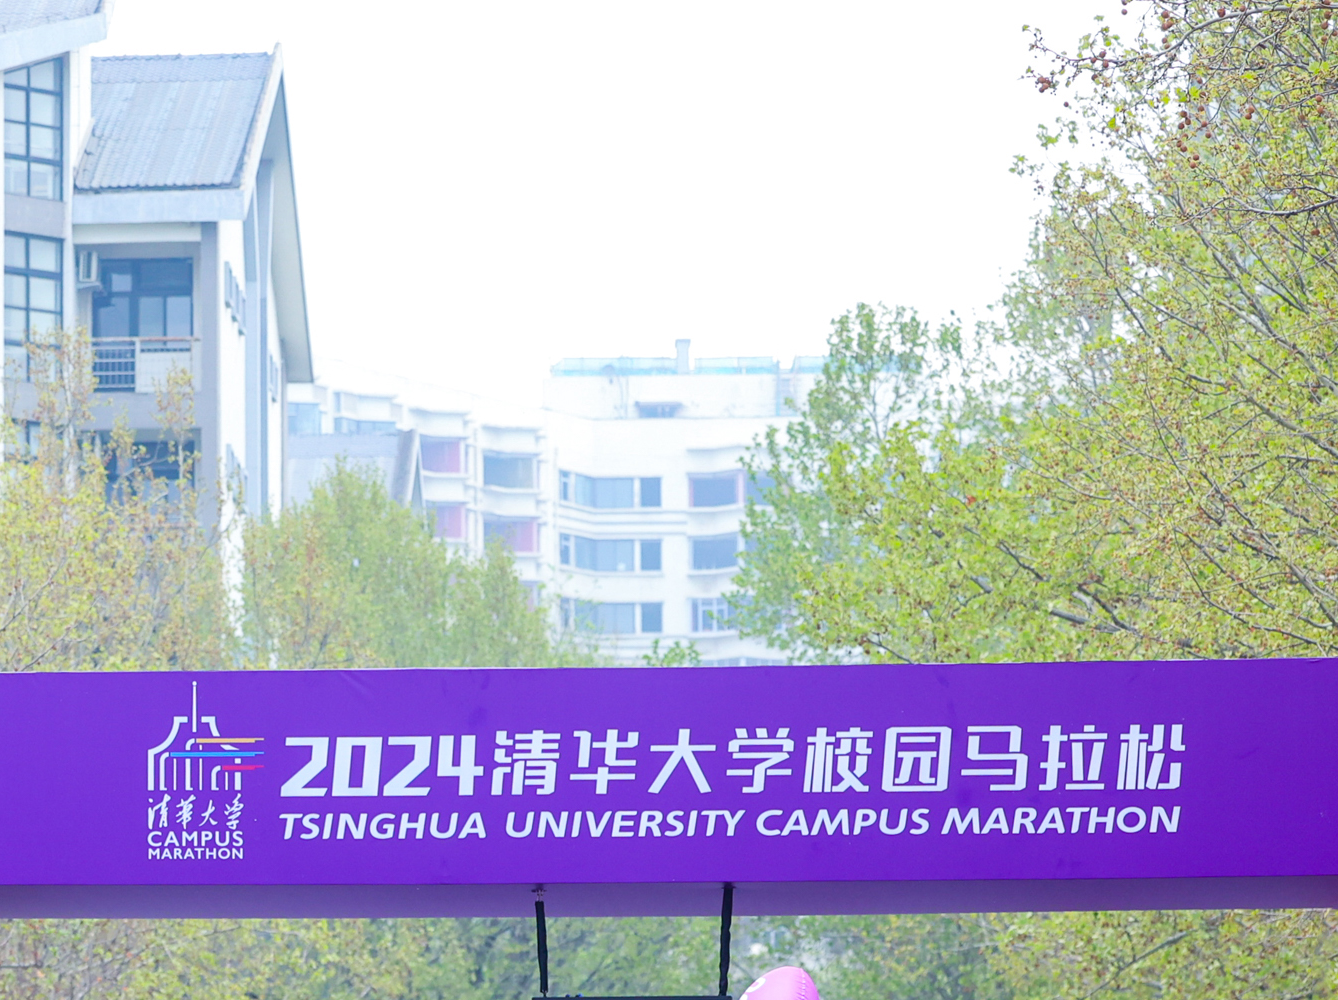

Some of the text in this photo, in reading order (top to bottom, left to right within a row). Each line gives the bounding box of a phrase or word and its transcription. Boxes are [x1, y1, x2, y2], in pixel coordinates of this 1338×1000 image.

[279, 724, 1187, 798] 2024清华大学校园马拉松
[279, 805, 1182, 840] TSINGHUA UNIVERSITY CAMPUS MARATHON
[147, 830, 244, 848] CAMPUS
[148, 847, 244, 860] MARATHON
